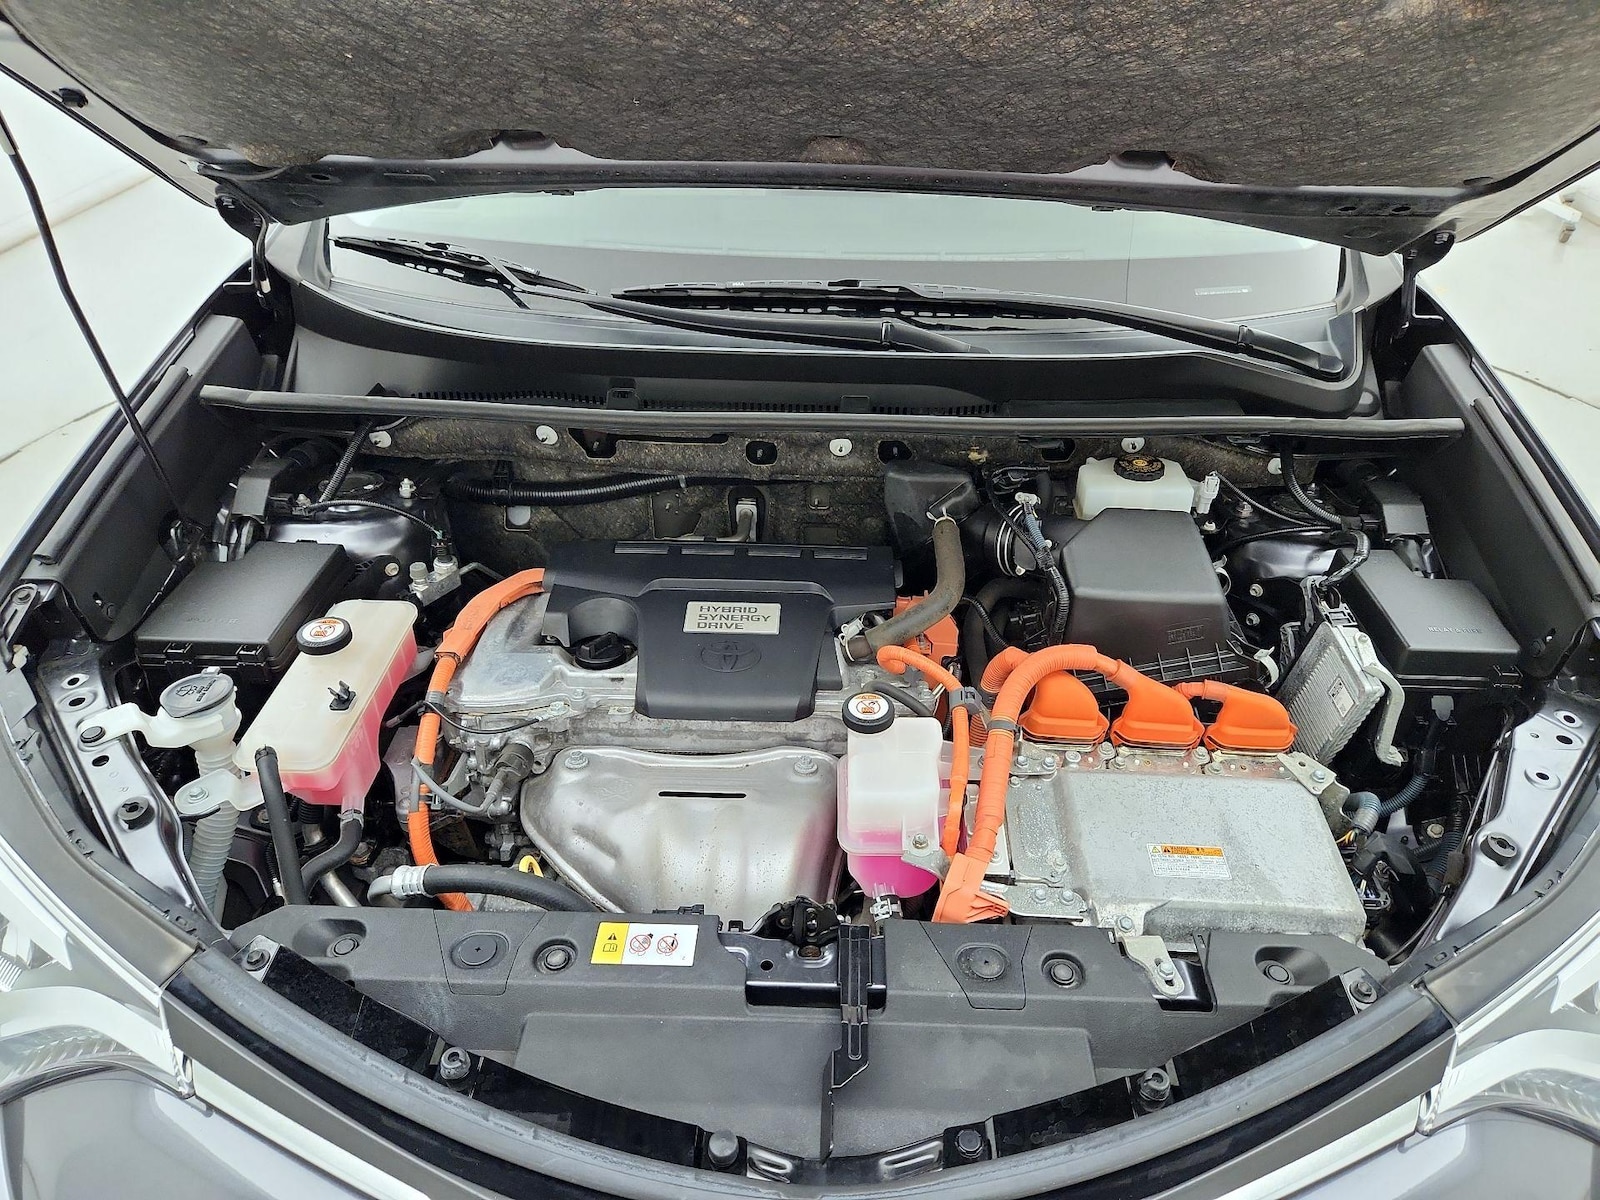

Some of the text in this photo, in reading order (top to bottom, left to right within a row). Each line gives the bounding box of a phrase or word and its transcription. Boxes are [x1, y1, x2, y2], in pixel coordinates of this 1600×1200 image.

[699, 605, 758, 613] HYBRID
[698, 614, 771, 622] SYNERGY
[697, 622, 744, 630] DRIVE
